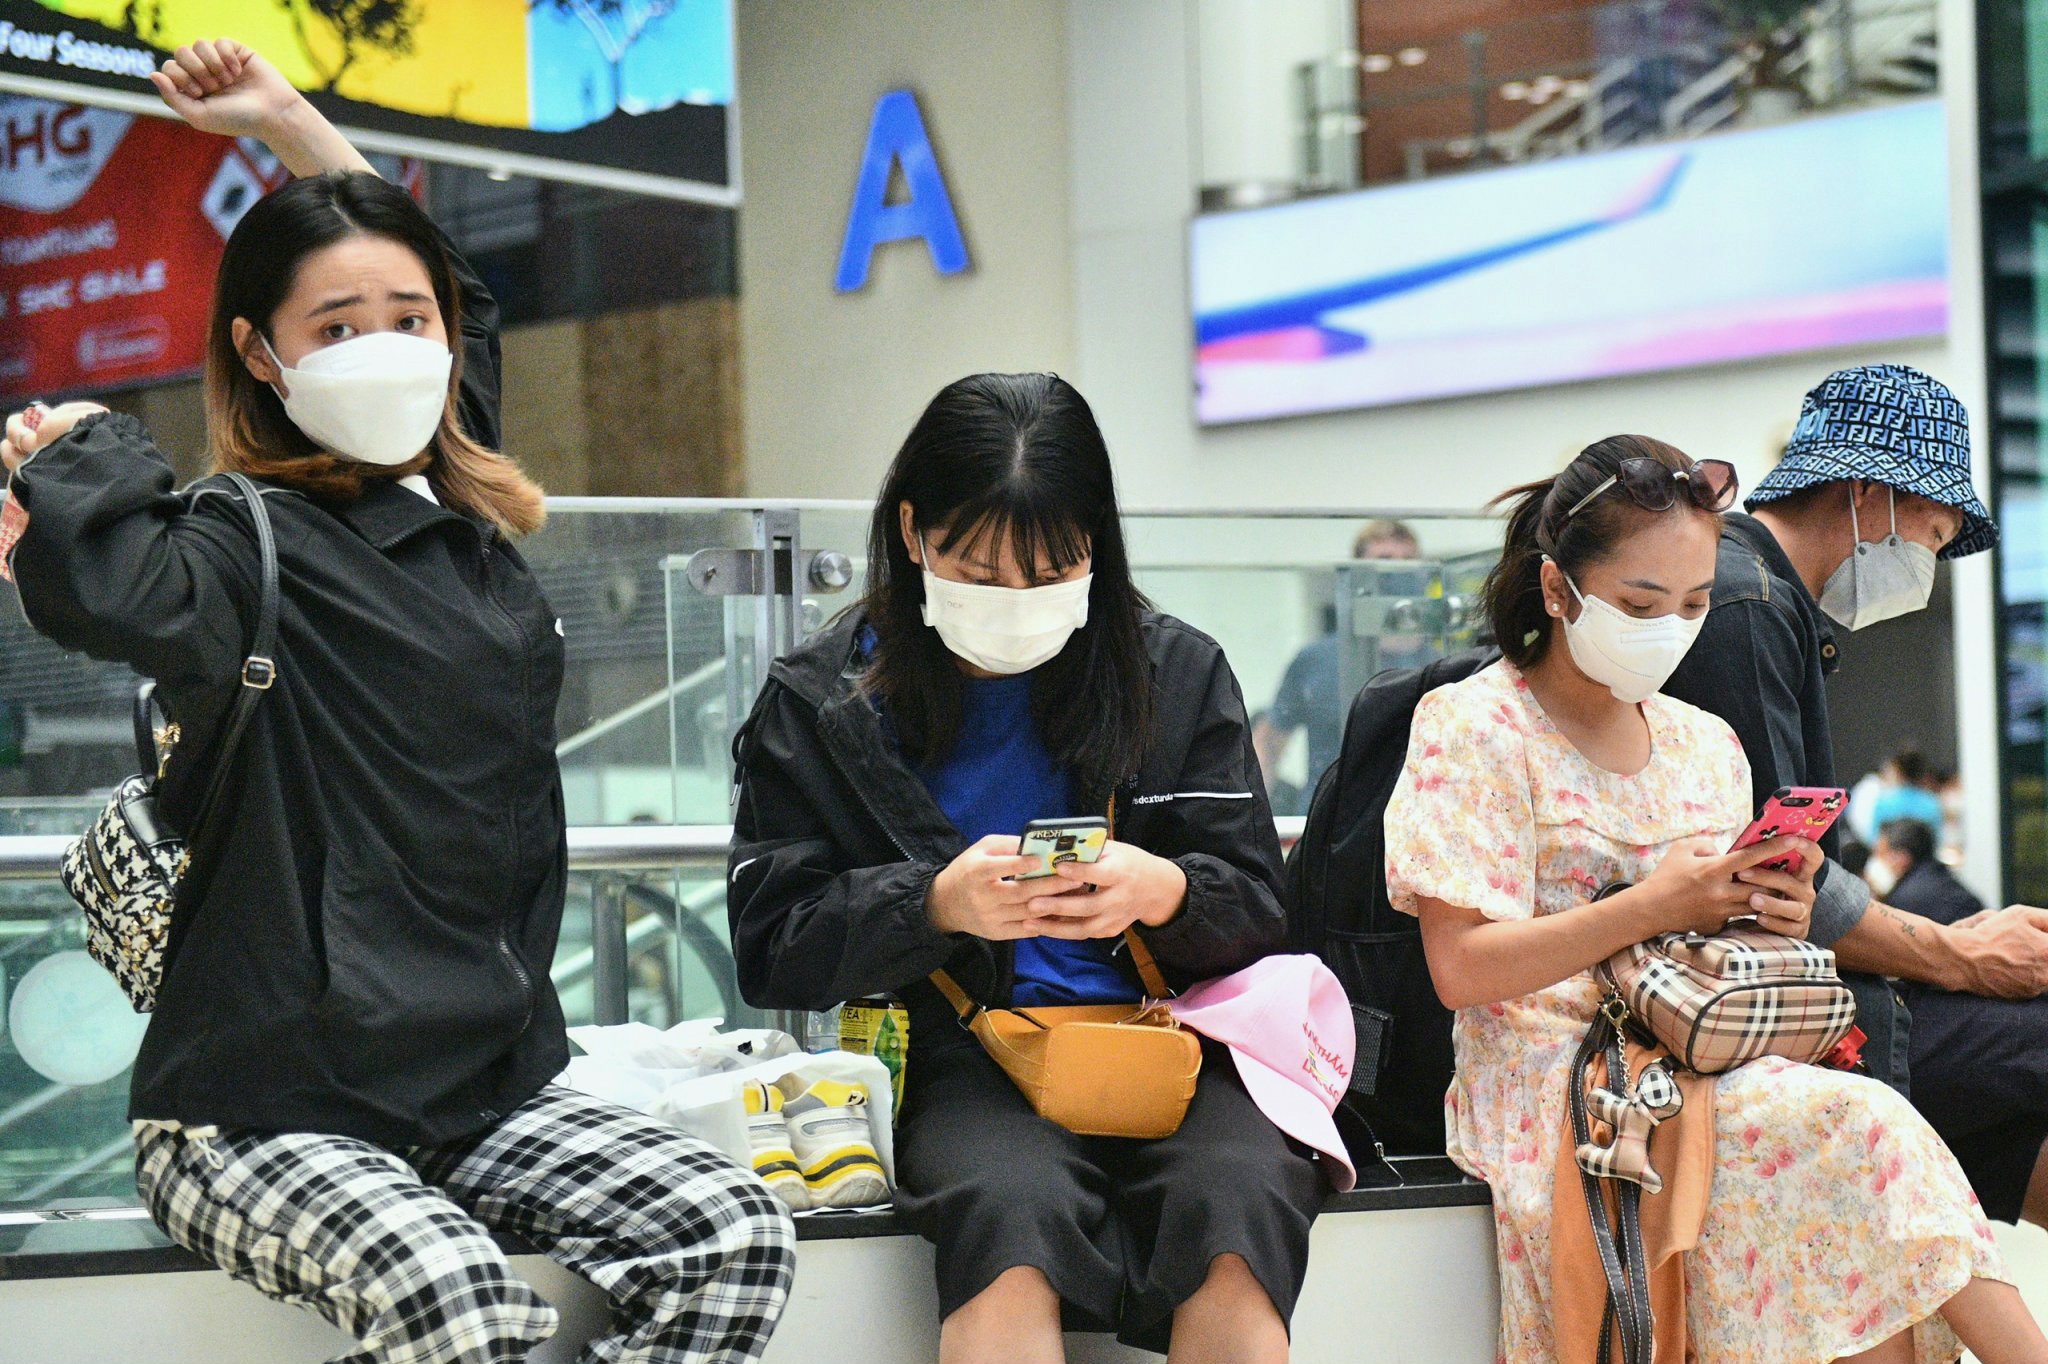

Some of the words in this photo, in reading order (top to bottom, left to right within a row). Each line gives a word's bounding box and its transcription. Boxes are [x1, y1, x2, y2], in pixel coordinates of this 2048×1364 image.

[56, 30, 156, 79] Seasons
[833, 88, 969, 293] A
[843, 1007, 860, 1020] TEA
